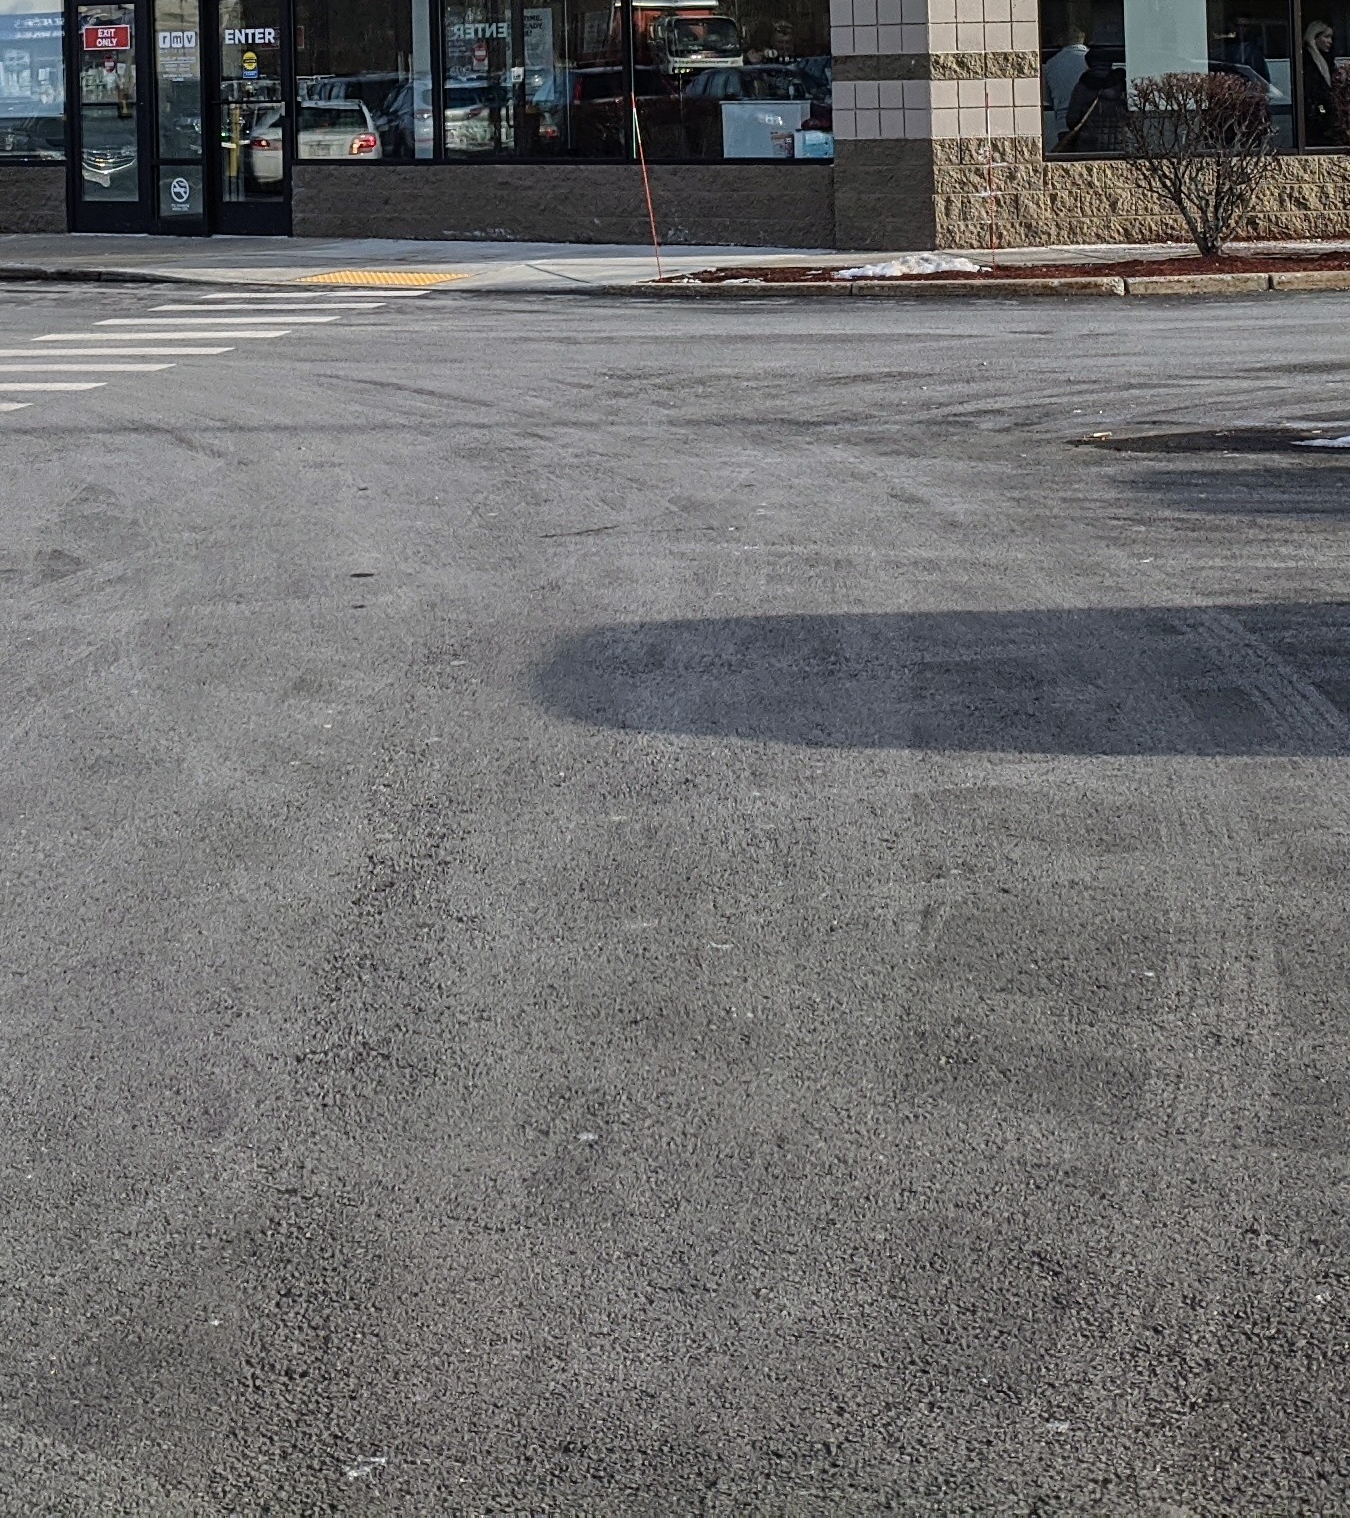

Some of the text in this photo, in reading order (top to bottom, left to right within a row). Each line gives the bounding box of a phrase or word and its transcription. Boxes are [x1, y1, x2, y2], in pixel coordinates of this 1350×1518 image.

[97, 28, 116, 38] EXIT
[225, 28, 275, 44] ENTER
[96, 38, 118, 47] ONLY
[161, 34, 194, 46] rmv
